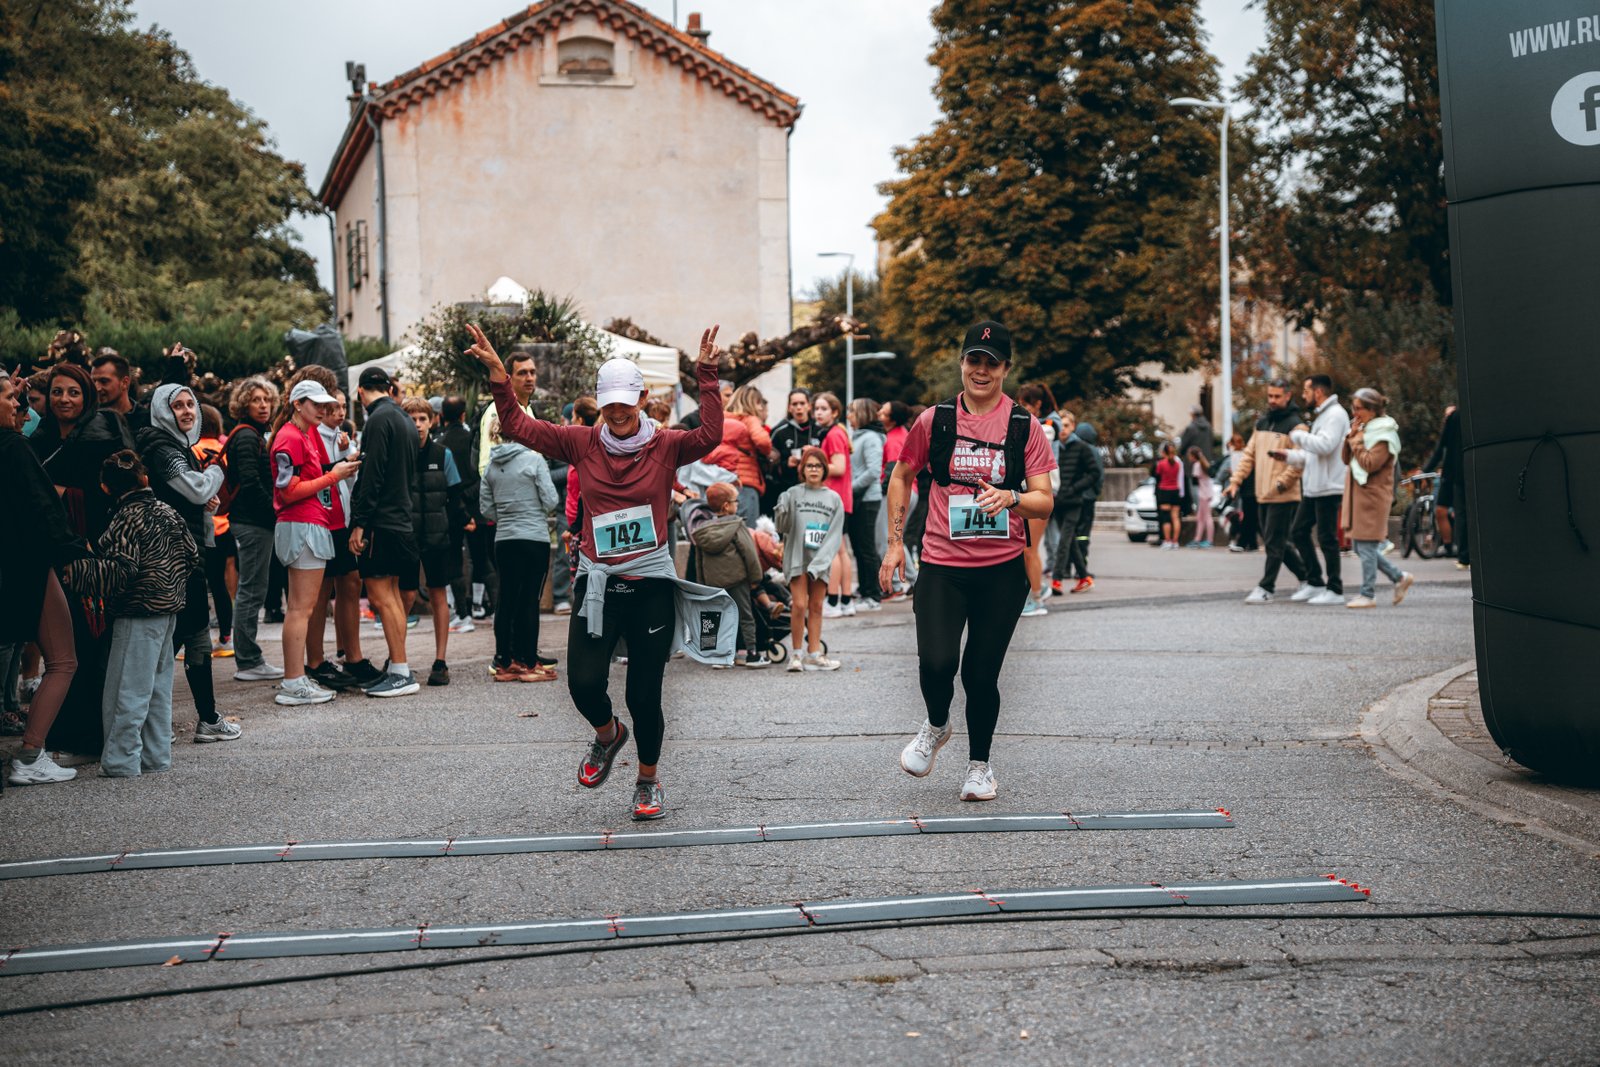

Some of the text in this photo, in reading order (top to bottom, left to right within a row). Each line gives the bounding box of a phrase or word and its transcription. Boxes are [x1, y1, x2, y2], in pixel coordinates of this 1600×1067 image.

[954, 457, 991, 467] COURSE
[962, 508, 997, 529] 744
[605, 521, 643, 549] 742
